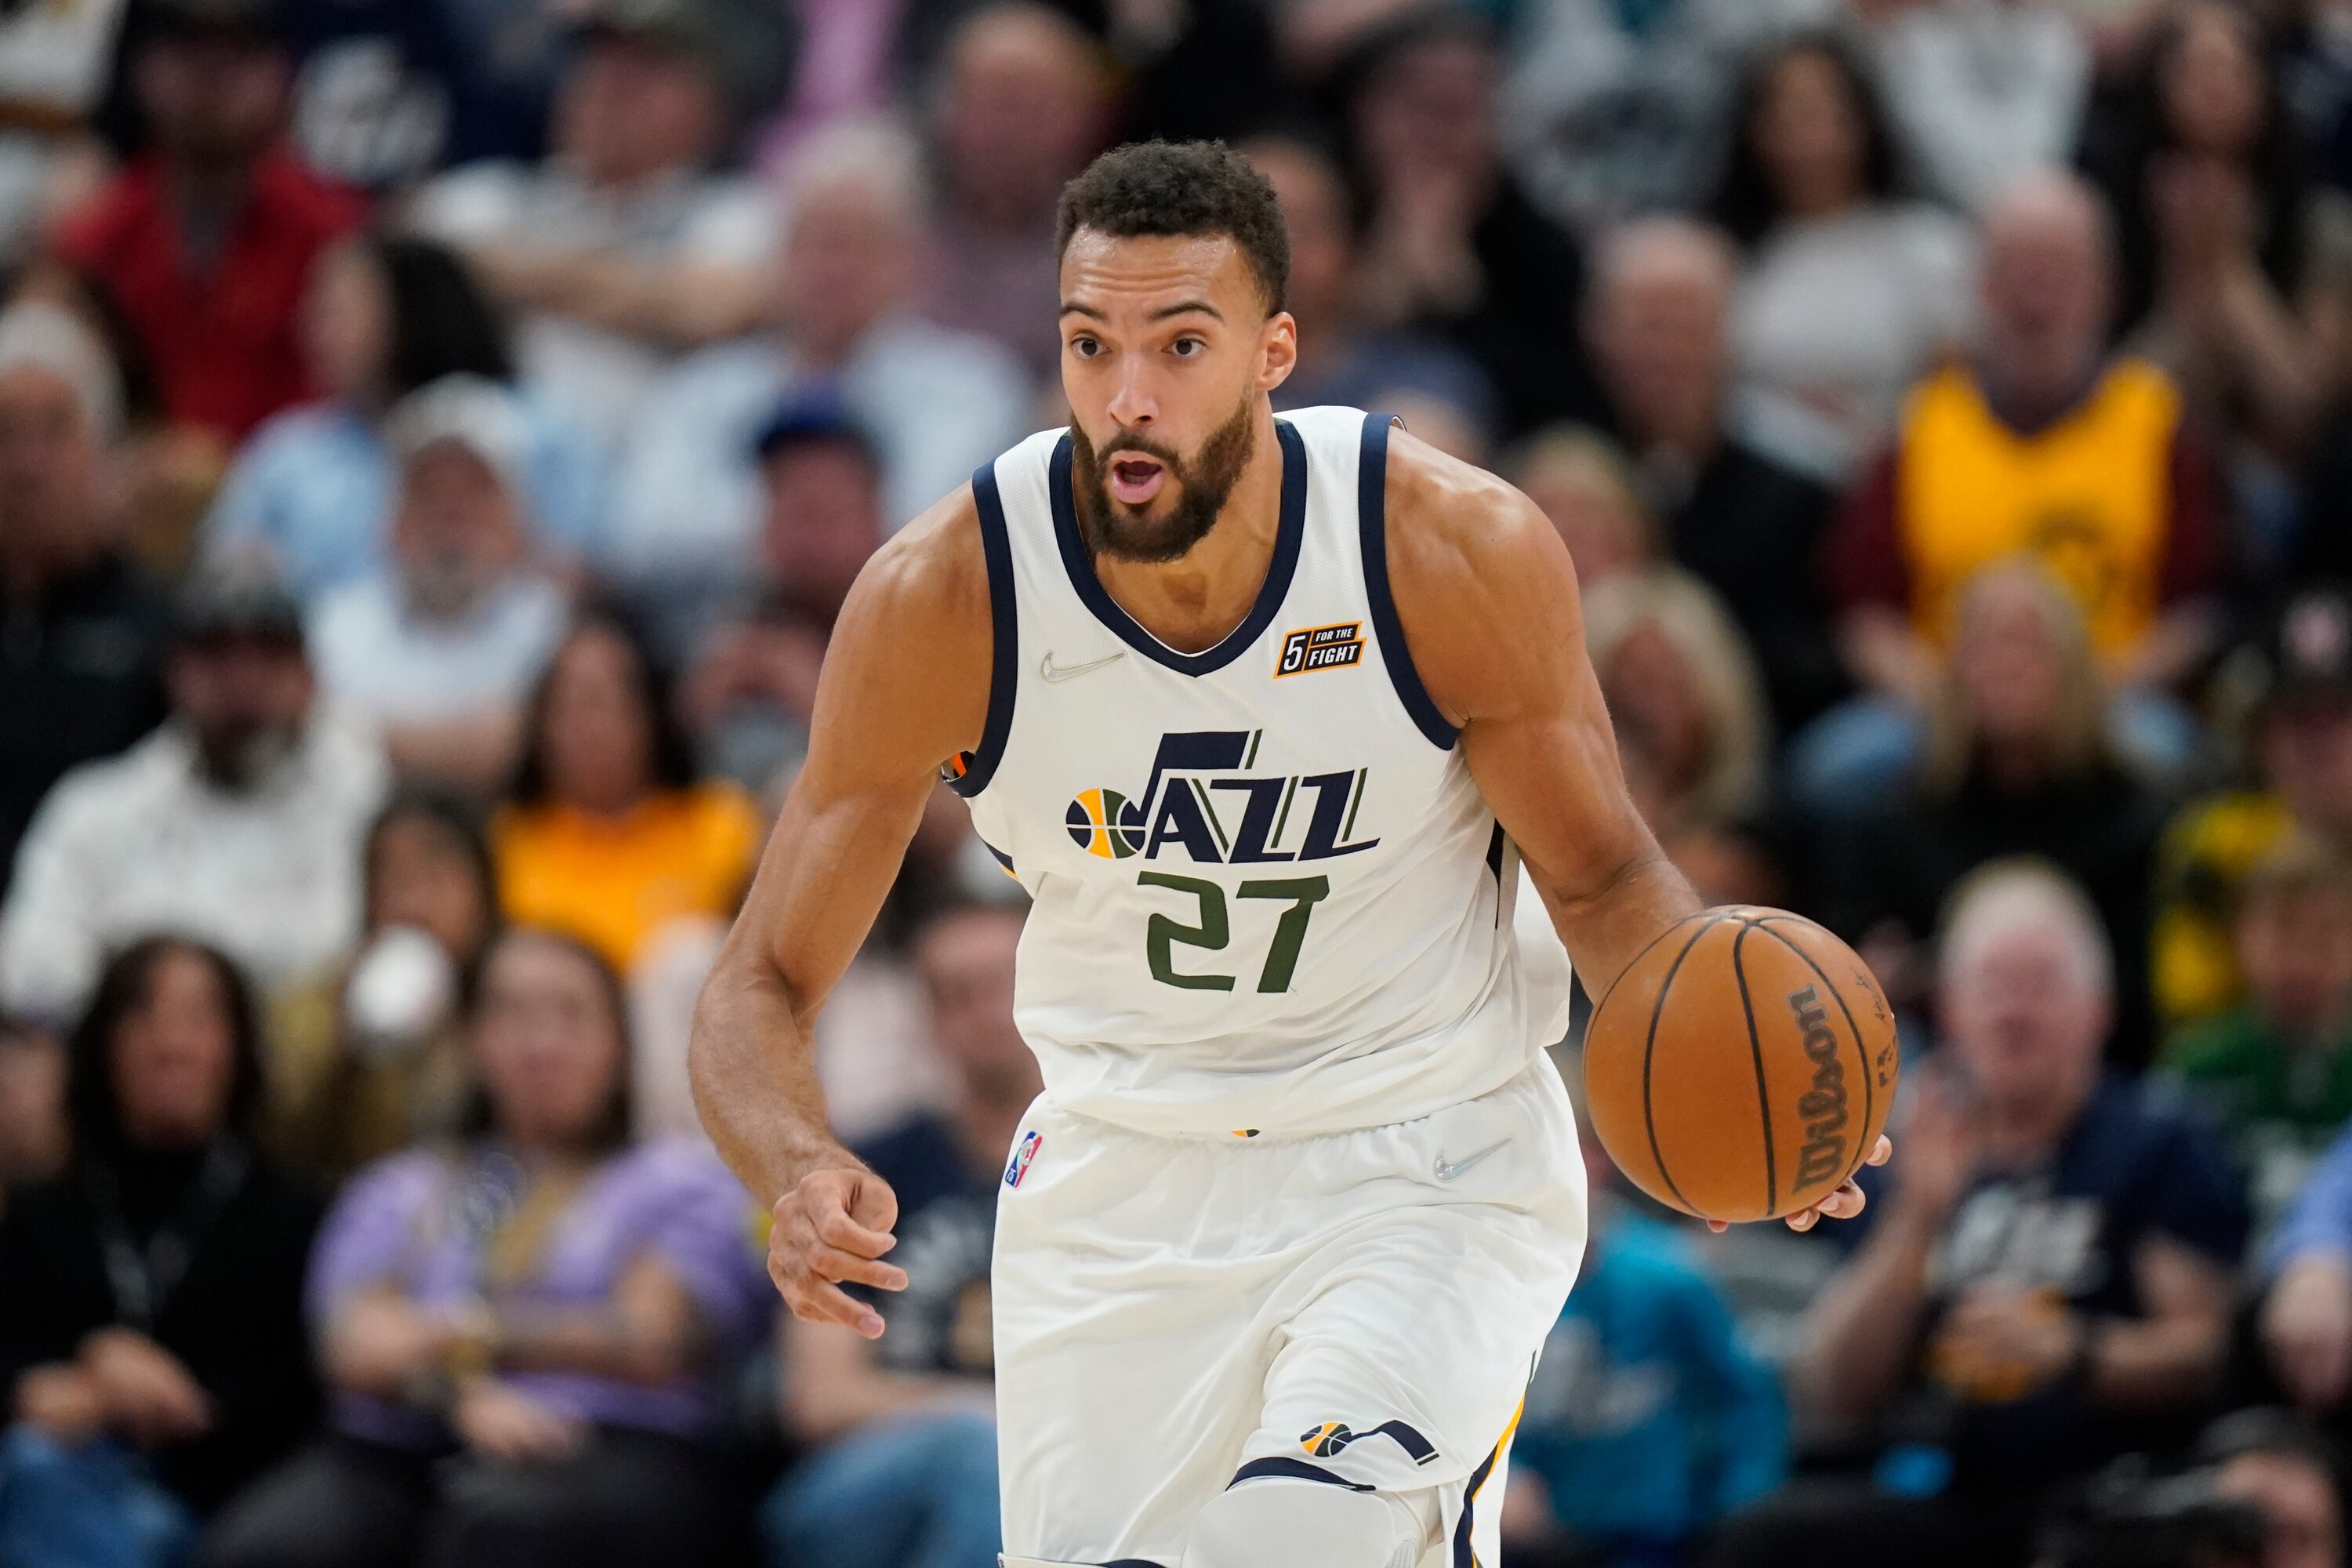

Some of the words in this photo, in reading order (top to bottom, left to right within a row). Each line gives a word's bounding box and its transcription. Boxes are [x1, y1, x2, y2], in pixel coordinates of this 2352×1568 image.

[1283, 634, 1306, 671] 5
[1308, 644, 1358, 666] FIGHT
[1315, 630, 1334, 642] FOR
[1335, 628, 1353, 639] THE
[1065, 729, 1381, 863] JAZZ
[1137, 870, 1330, 993] 27
[1788, 984, 1848, 1196] Wilson
